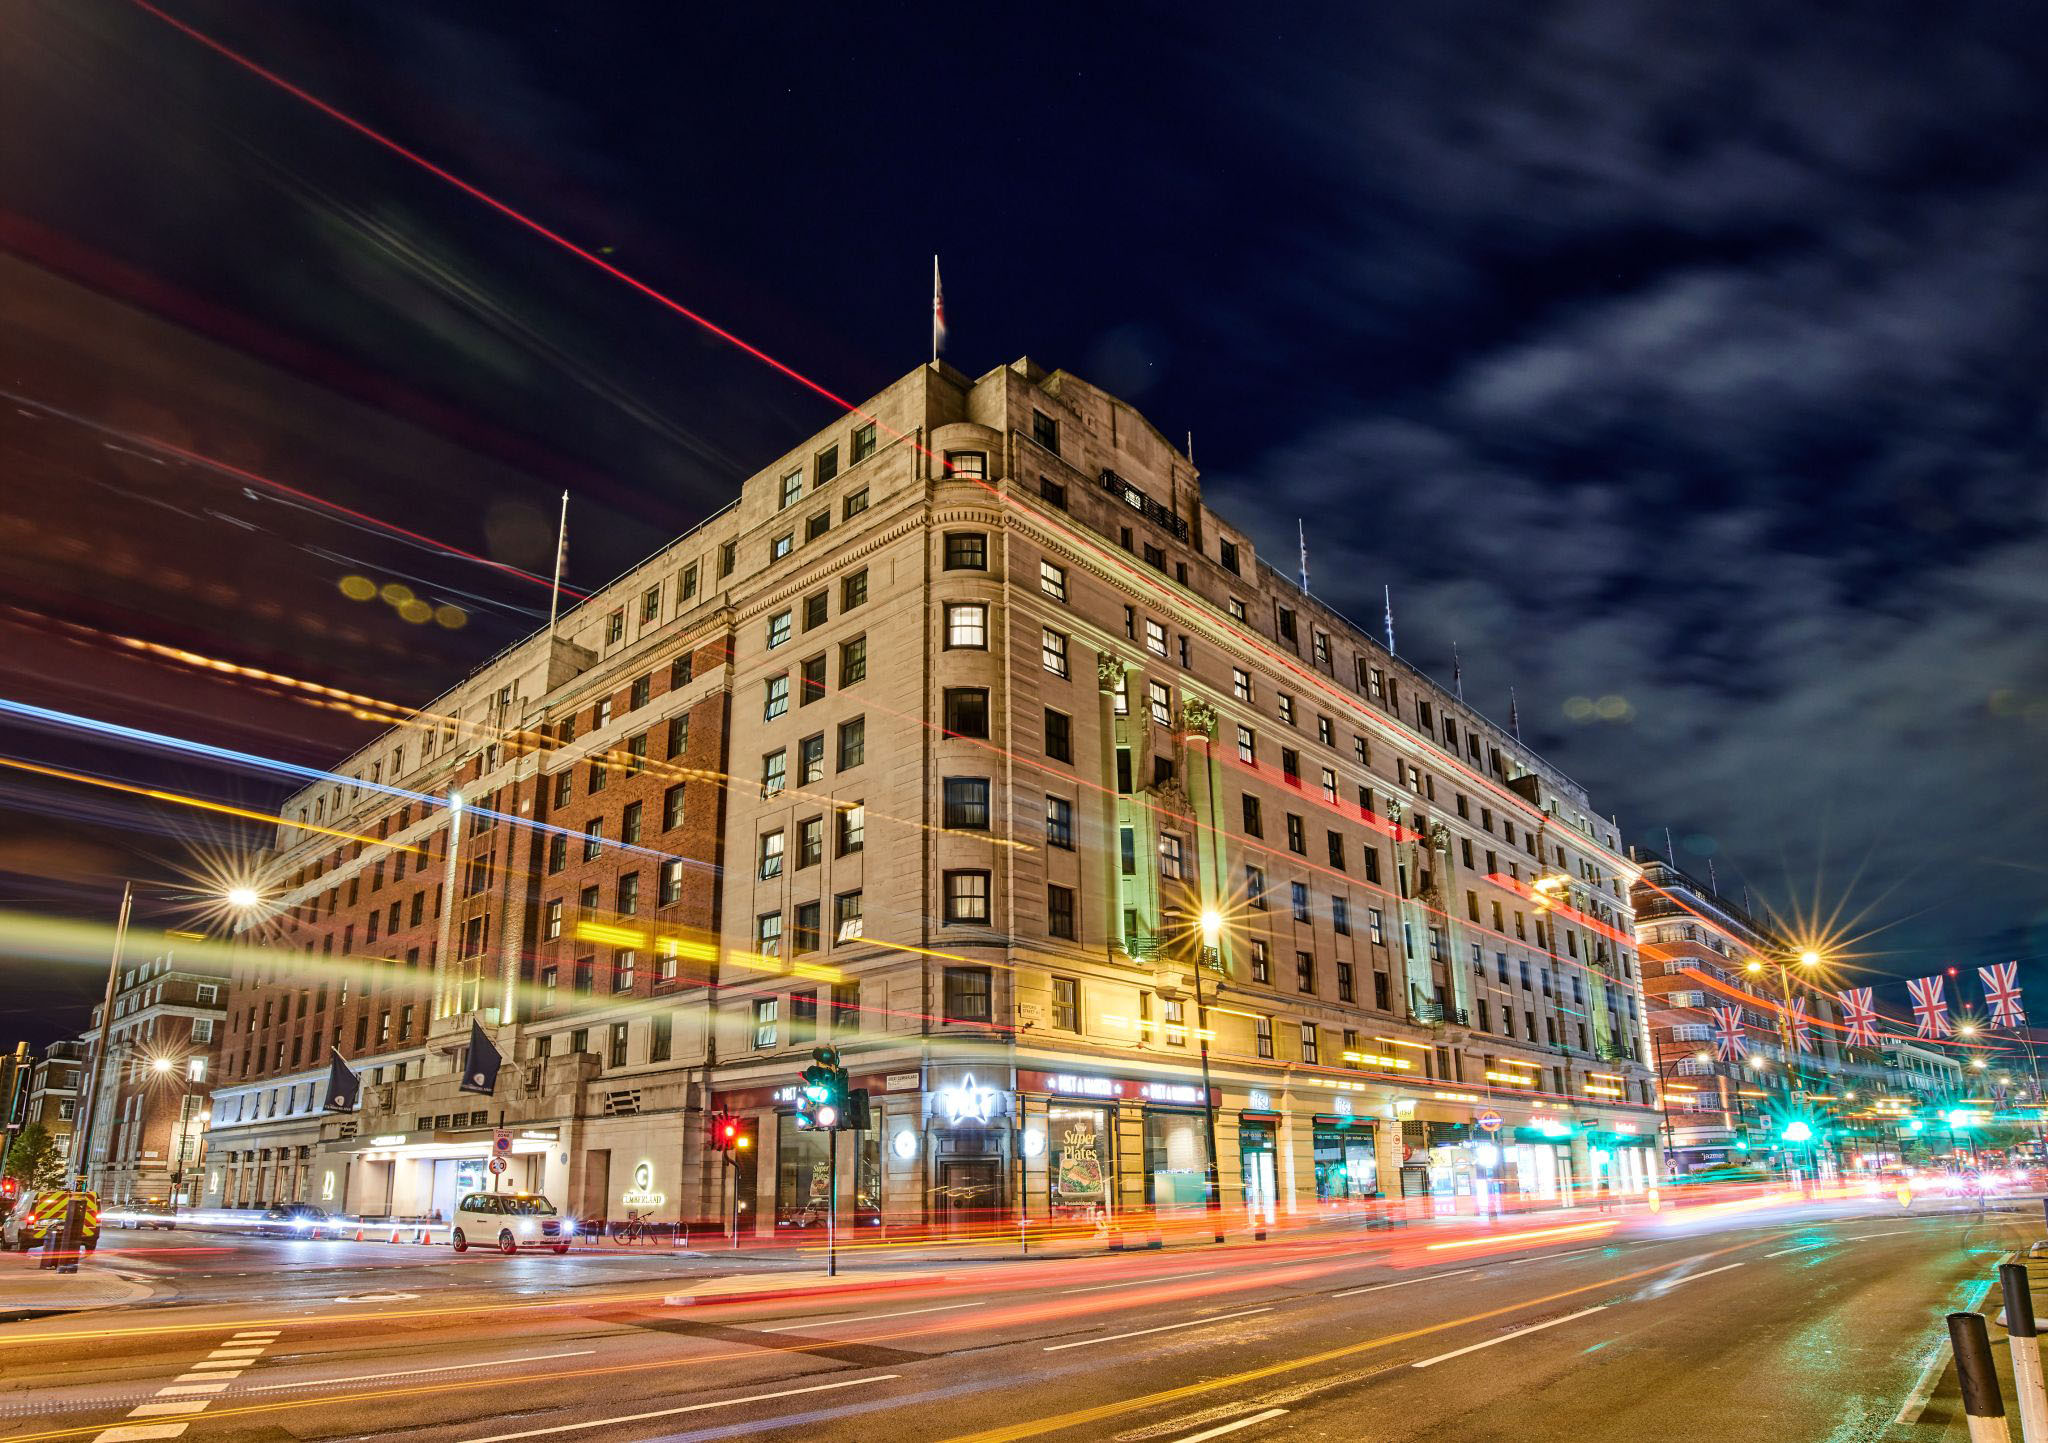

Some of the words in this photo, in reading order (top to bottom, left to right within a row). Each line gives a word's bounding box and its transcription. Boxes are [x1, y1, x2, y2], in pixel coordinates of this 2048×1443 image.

[1251, 1090, 1270, 1109] itsu
[1335, 1096, 1352, 1114] itsu
[1064, 1130, 1096, 1149] Super
[1064, 1146, 1097, 1161] Plates
[813, 1165, 830, 1174] Super
